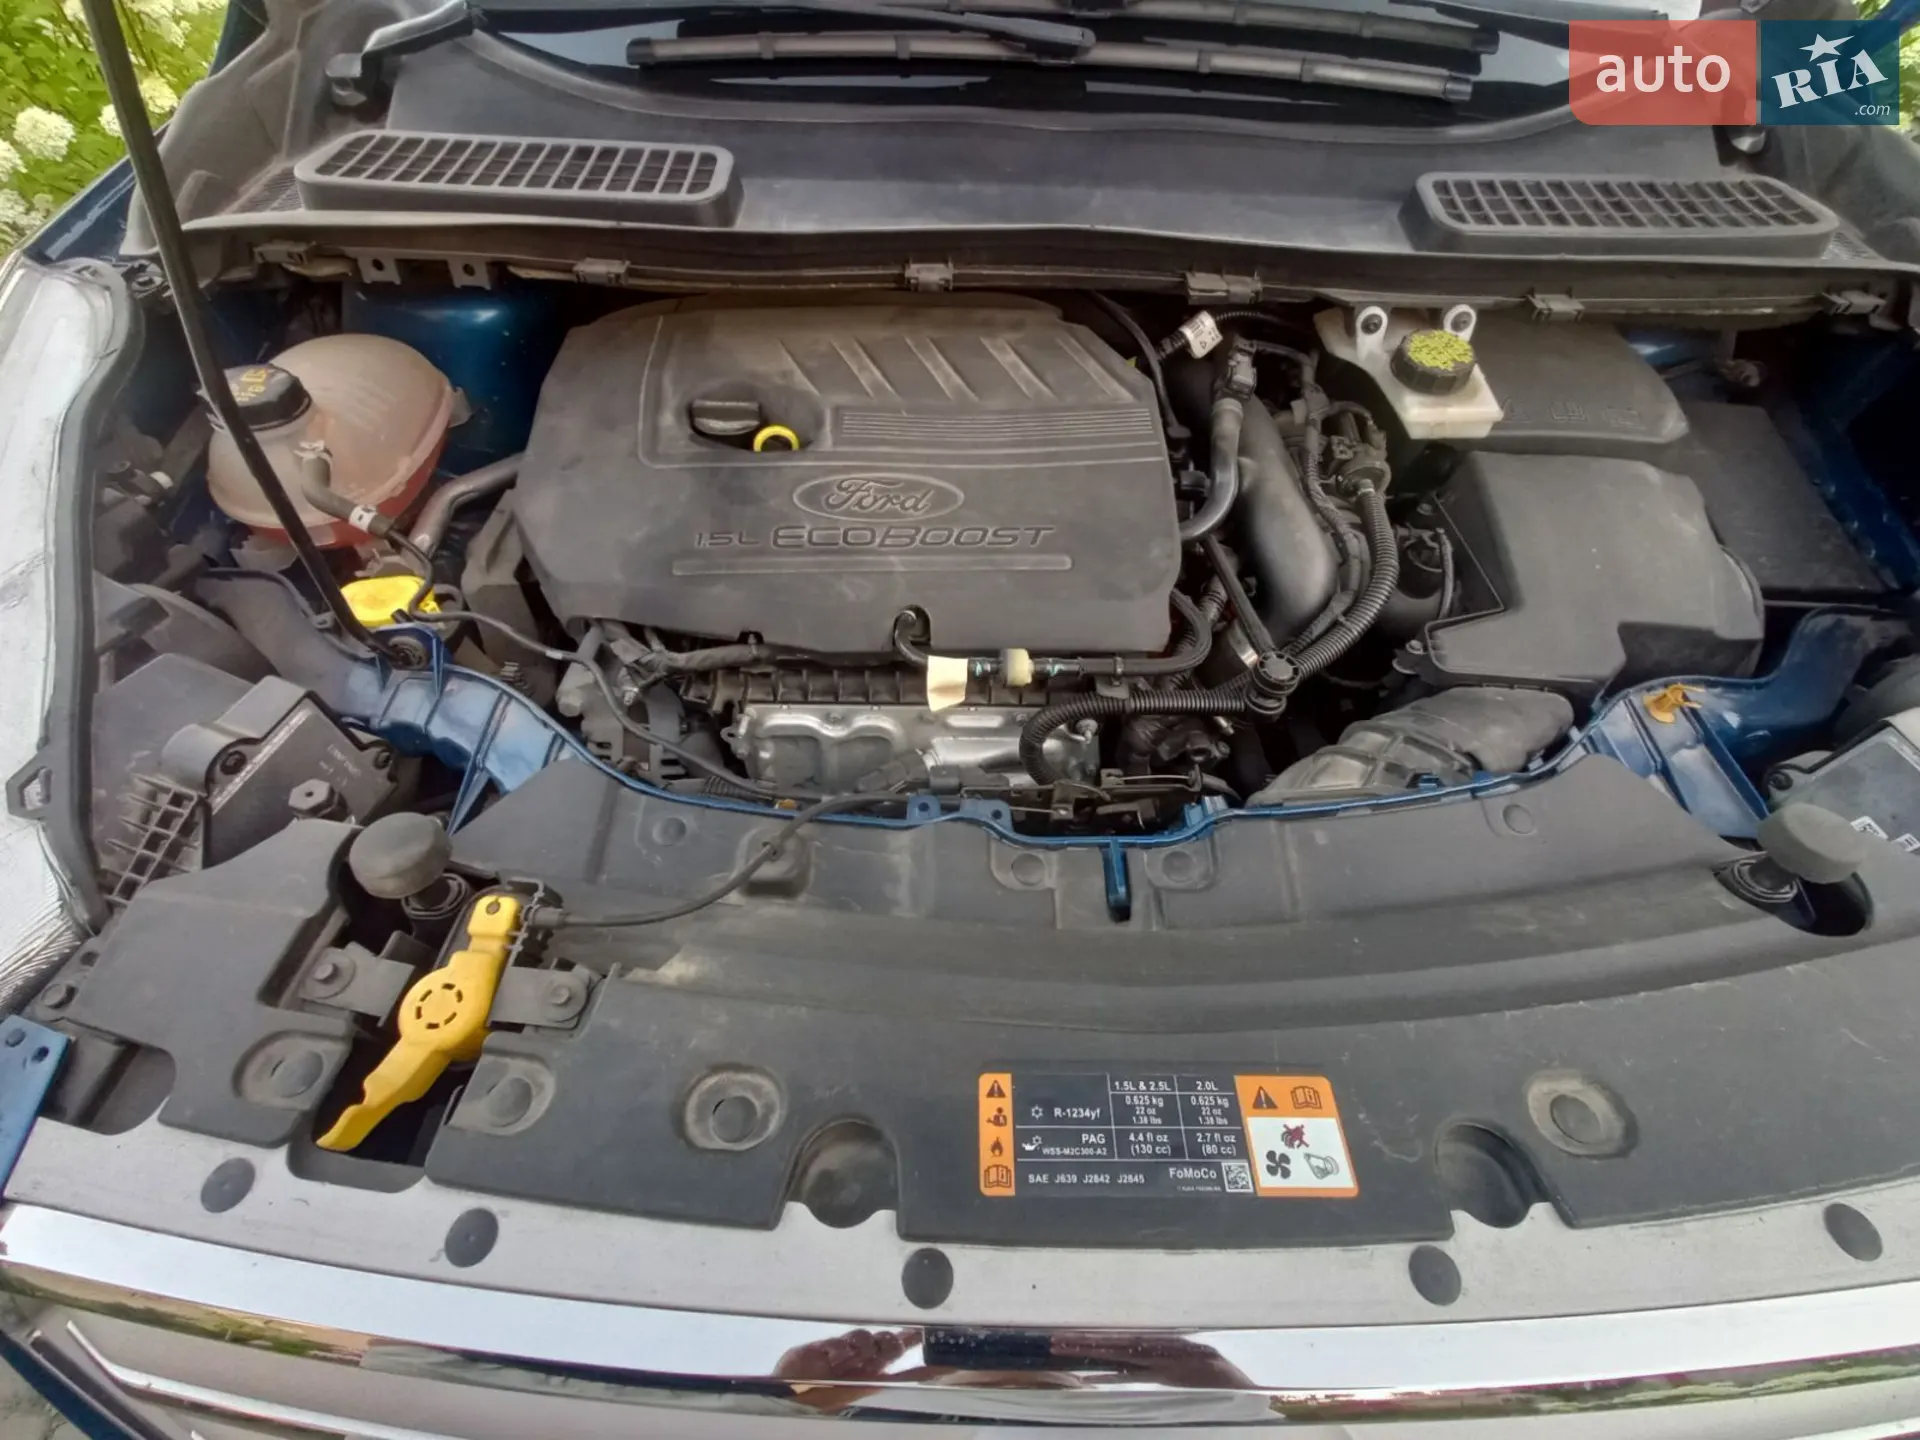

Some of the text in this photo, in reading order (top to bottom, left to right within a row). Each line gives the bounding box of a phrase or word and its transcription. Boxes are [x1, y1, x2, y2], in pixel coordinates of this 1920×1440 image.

[823, 478, 938, 514] Ford
[1115, 1080, 1171, 1091] 1.5L & 2.5L
[1195, 1080, 1218, 1091] 2.0L
[1125, 1095, 1164, 1107] 0.625 kg
[1190, 1096, 1229, 1108] 0.625 kg
[1053, 1107, 1101, 1120] R-1234yf
[1135, 1107, 1145, 1115] 22
[1201, 1107, 1211, 1116] 22
[1081, 1133, 1106, 1144] PAG
[1128, 1132, 1169, 1142] 4.4 fl oz
[1196, 1132, 1236, 1143] 2.7 fl oz
[1131, 1143, 1171, 1156] (130 cc)
[1202, 1144, 1236, 1156] (80 cc)
[1028, 1173, 1049, 1184] SAE
[1168, 1167, 1217, 1180] FoMoCo
